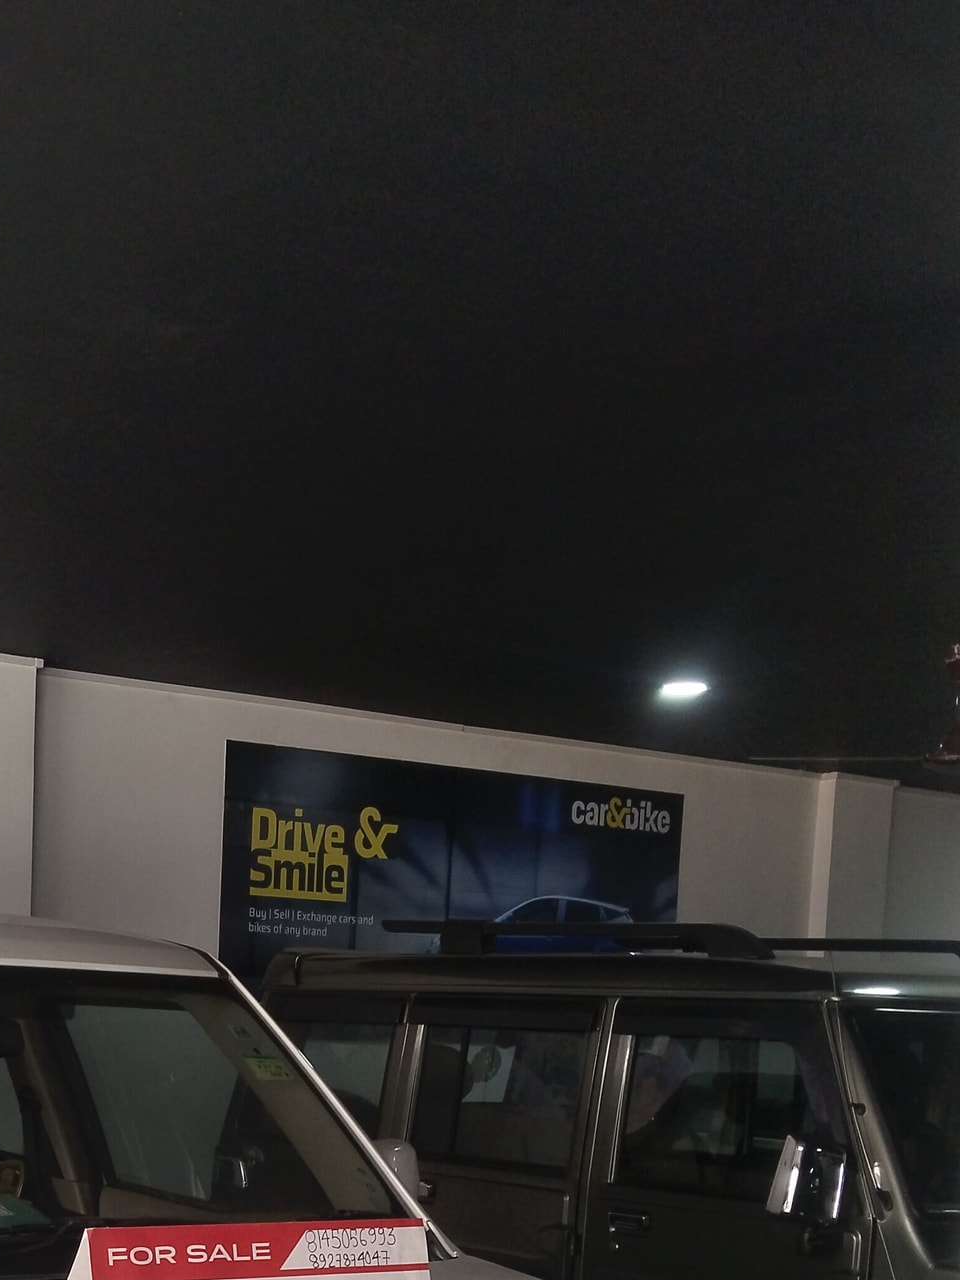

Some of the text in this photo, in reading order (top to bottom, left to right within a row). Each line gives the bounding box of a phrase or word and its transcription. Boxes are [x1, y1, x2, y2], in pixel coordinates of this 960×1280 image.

[571, 797, 671, 833] car&bike
[251, 806, 399, 860] Drive &
[249, 848, 345, 895] Smile
[249, 907, 267, 920] Buy
[274, 909, 290, 920] Sell
[297, 911, 337, 925] Exchange
[339, 914, 356, 924] cars
[358, 915, 374, 926] and
[248, 922, 328, 937] bikes of any brand
[305, 1228, 396, 1253] 8145056993
[107, 1242, 271, 1266] FOR SALE
